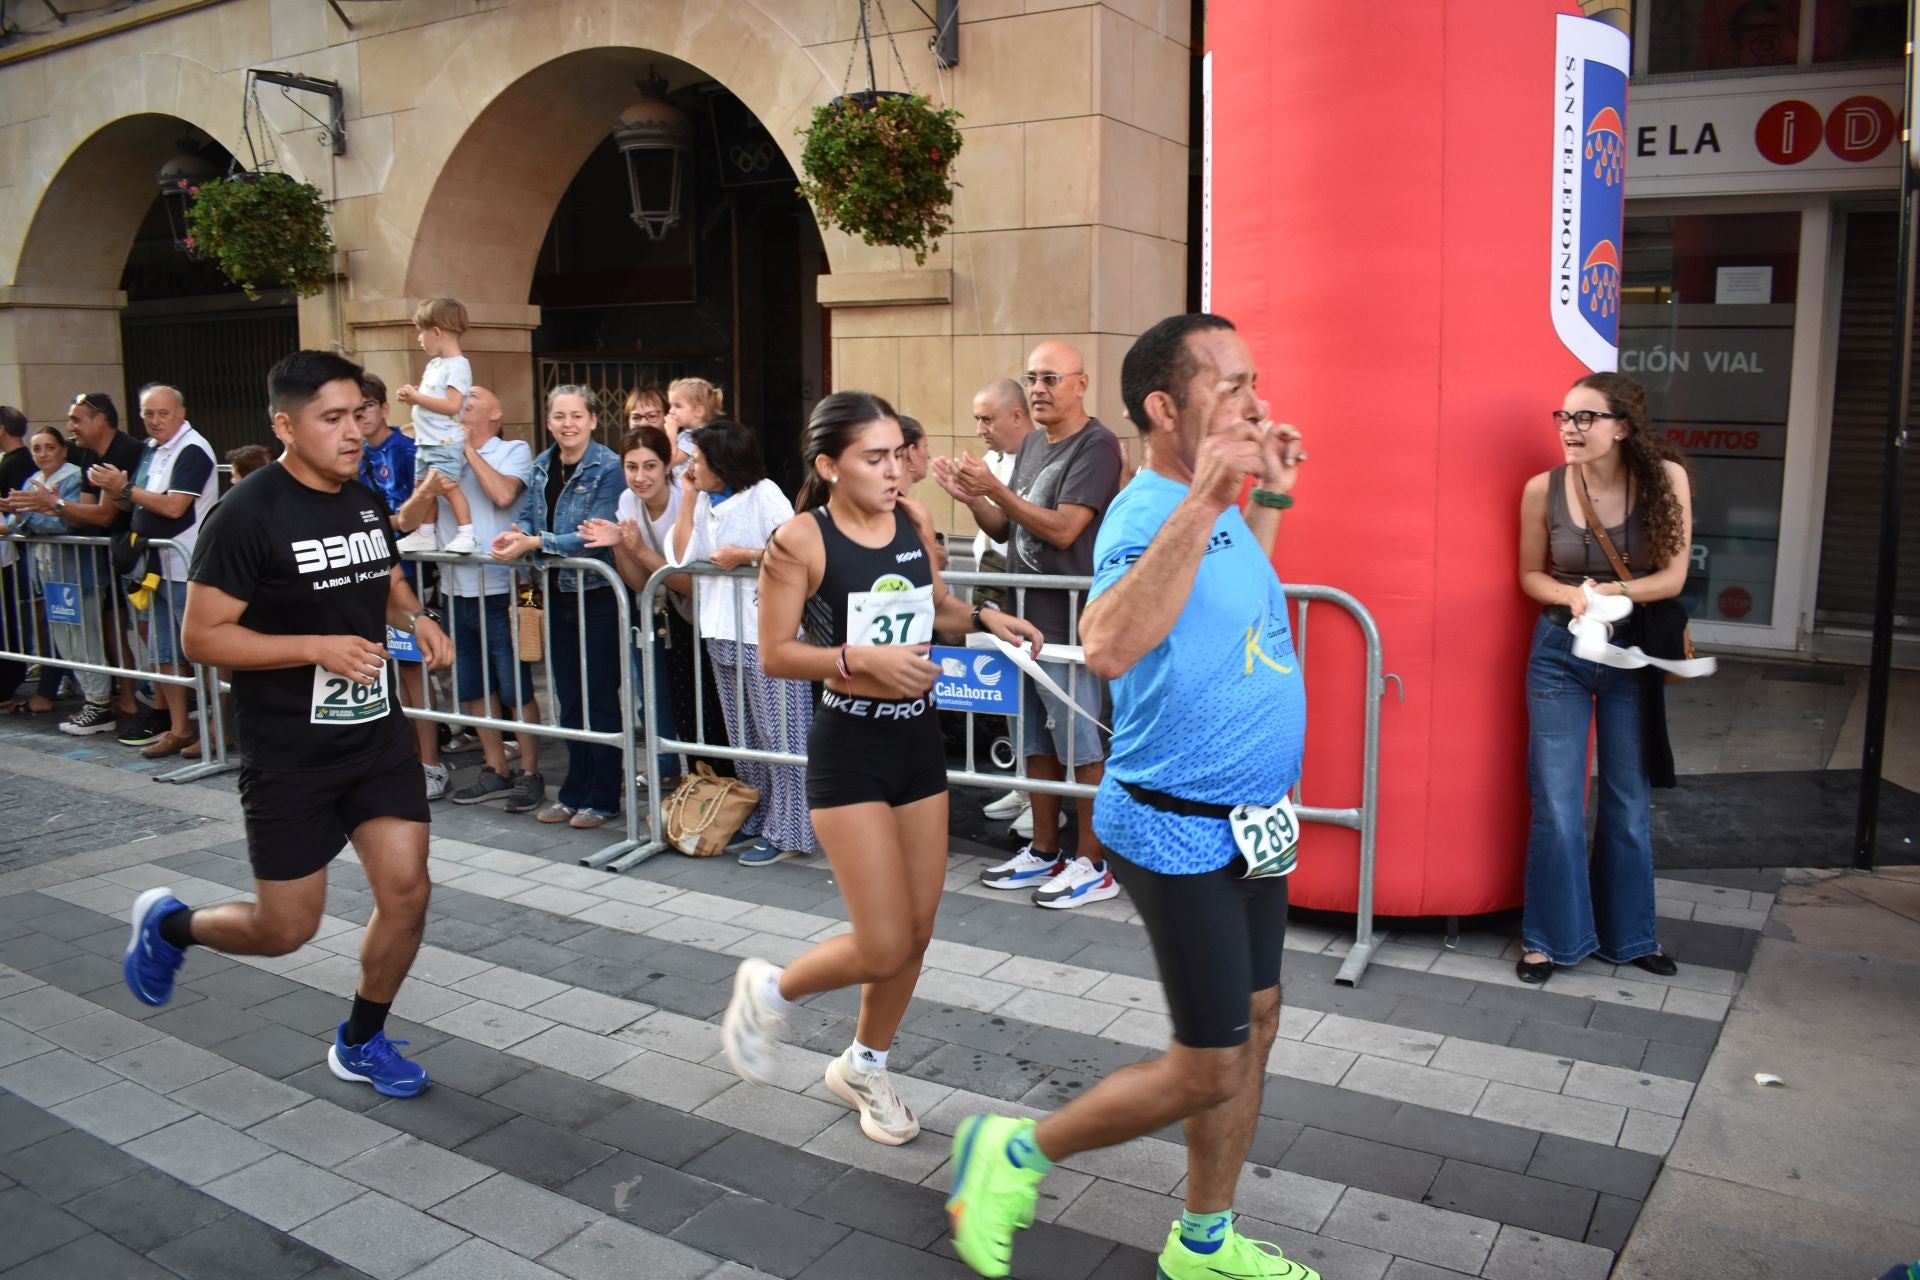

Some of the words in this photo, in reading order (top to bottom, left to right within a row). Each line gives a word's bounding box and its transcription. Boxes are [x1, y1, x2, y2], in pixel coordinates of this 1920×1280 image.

[1564, 56, 1576, 114] SAN
[1637, 122, 1722, 157] ELA
[1560, 125, 1575, 306] CELEDONIO
[1620, 345, 1689, 373] CIÓN
[1703, 351, 1764, 373] VIAL
[1666, 428, 1760, 450] PUNTOS
[329, 575, 352, 588] RIOJA
[1719, 597, 1751, 608] STOP
[871, 613, 915, 647] 37
[323, 669, 382, 705] 264
[935, 682, 1002, 701] Calahorra
[873, 698, 926, 720] PRO
[1243, 807, 1294, 863] 289
